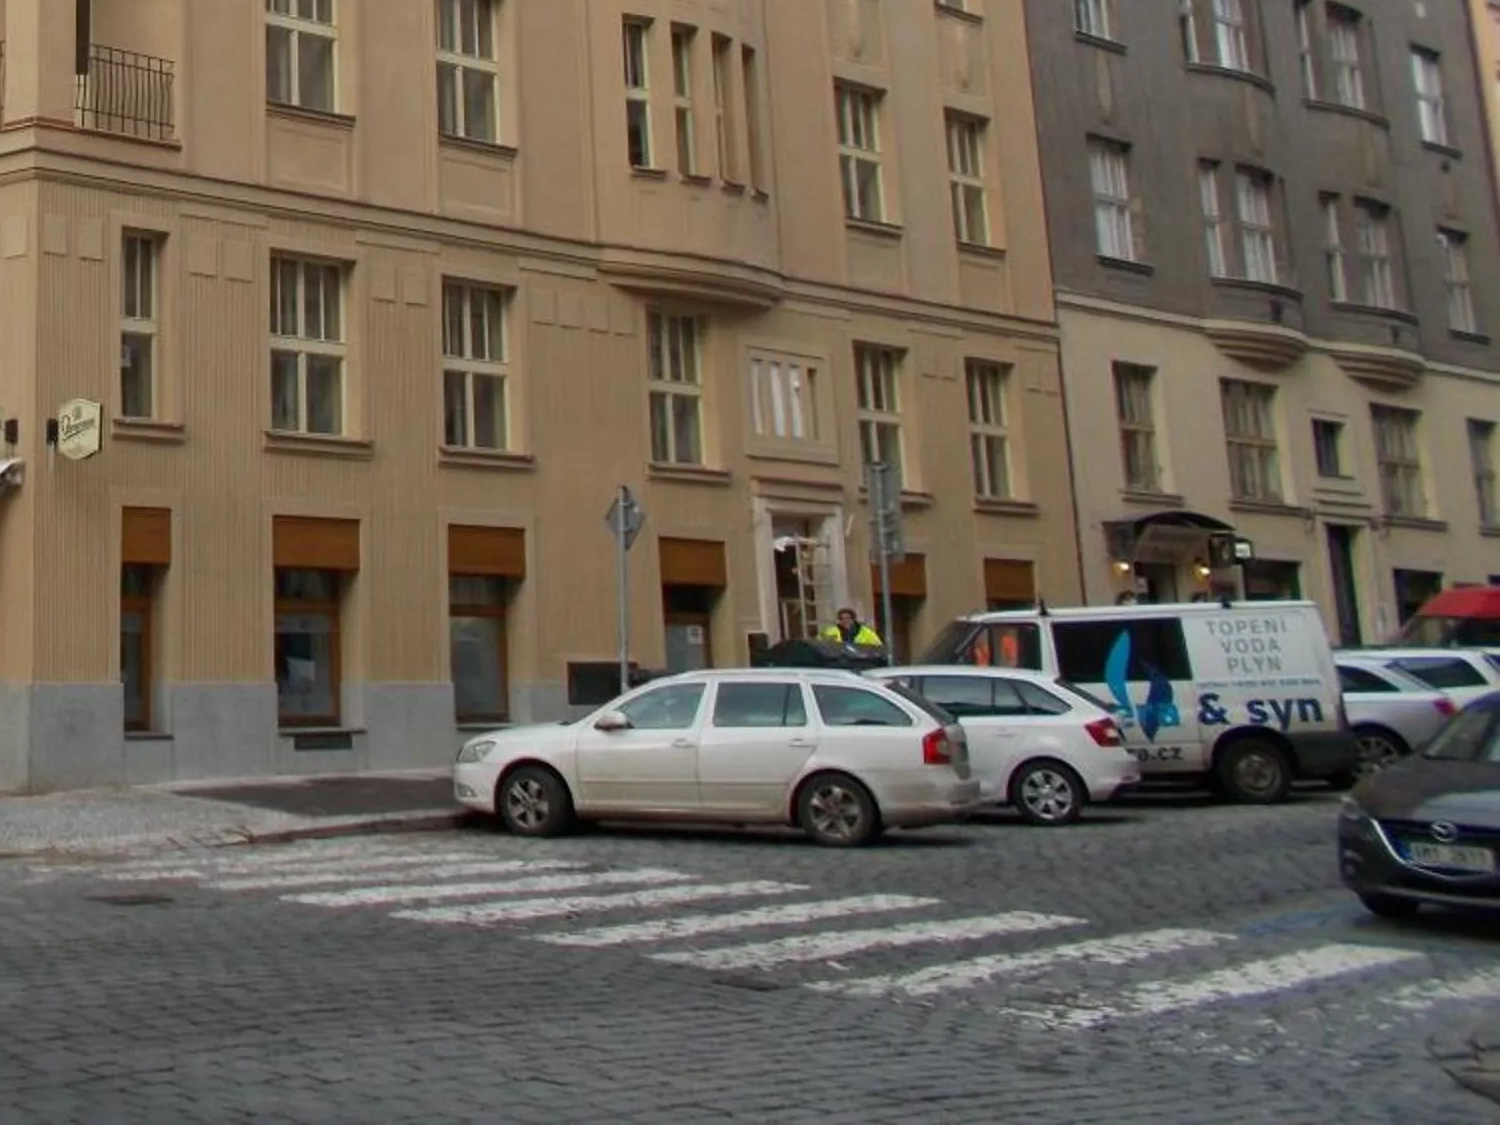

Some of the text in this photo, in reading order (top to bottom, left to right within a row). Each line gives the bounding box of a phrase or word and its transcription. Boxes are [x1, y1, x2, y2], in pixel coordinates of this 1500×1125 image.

[1219, 637, 1282, 654] VODA
[1227, 656, 1282, 674] PLYN
[1198, 693, 1230, 725] &
[1246, 697, 1324, 733] syn
